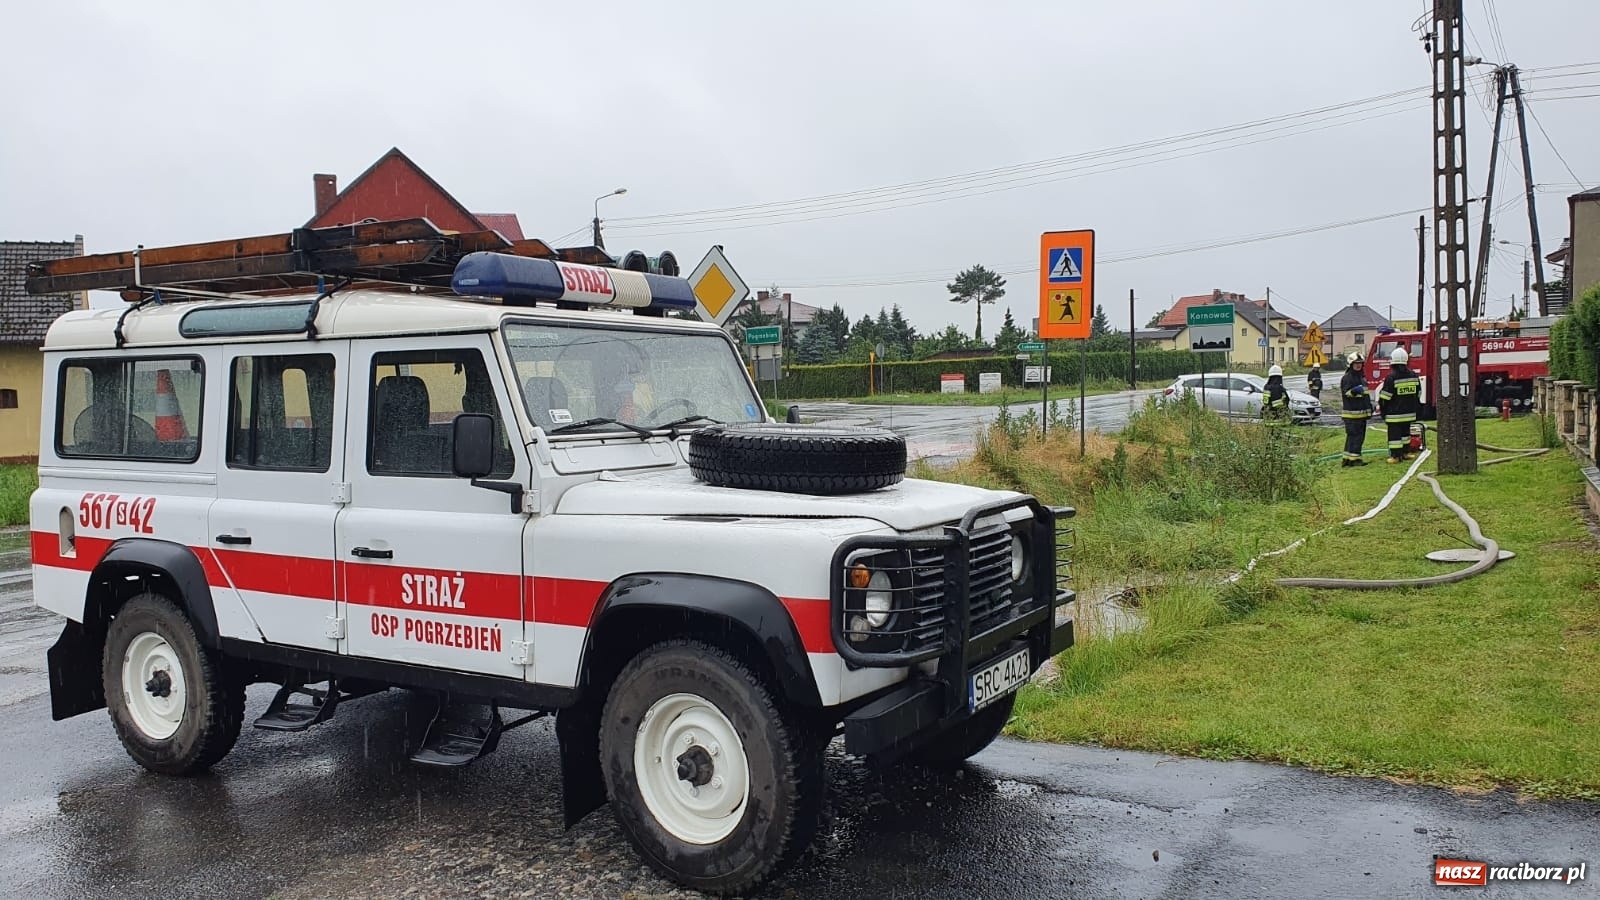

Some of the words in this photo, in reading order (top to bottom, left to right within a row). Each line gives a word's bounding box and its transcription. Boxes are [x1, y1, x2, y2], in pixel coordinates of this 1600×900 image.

[561, 266, 612, 295] STRAŻ
[1190, 312, 1230, 320] Kornowac
[401, 571, 466, 609] STRAŻ
[371, 612, 399, 638] OSP
[405, 618, 502, 652] POGRZEBIEŃ
[975, 666, 1001, 702] SRC
[1004, 651, 1029, 685] 4A23
